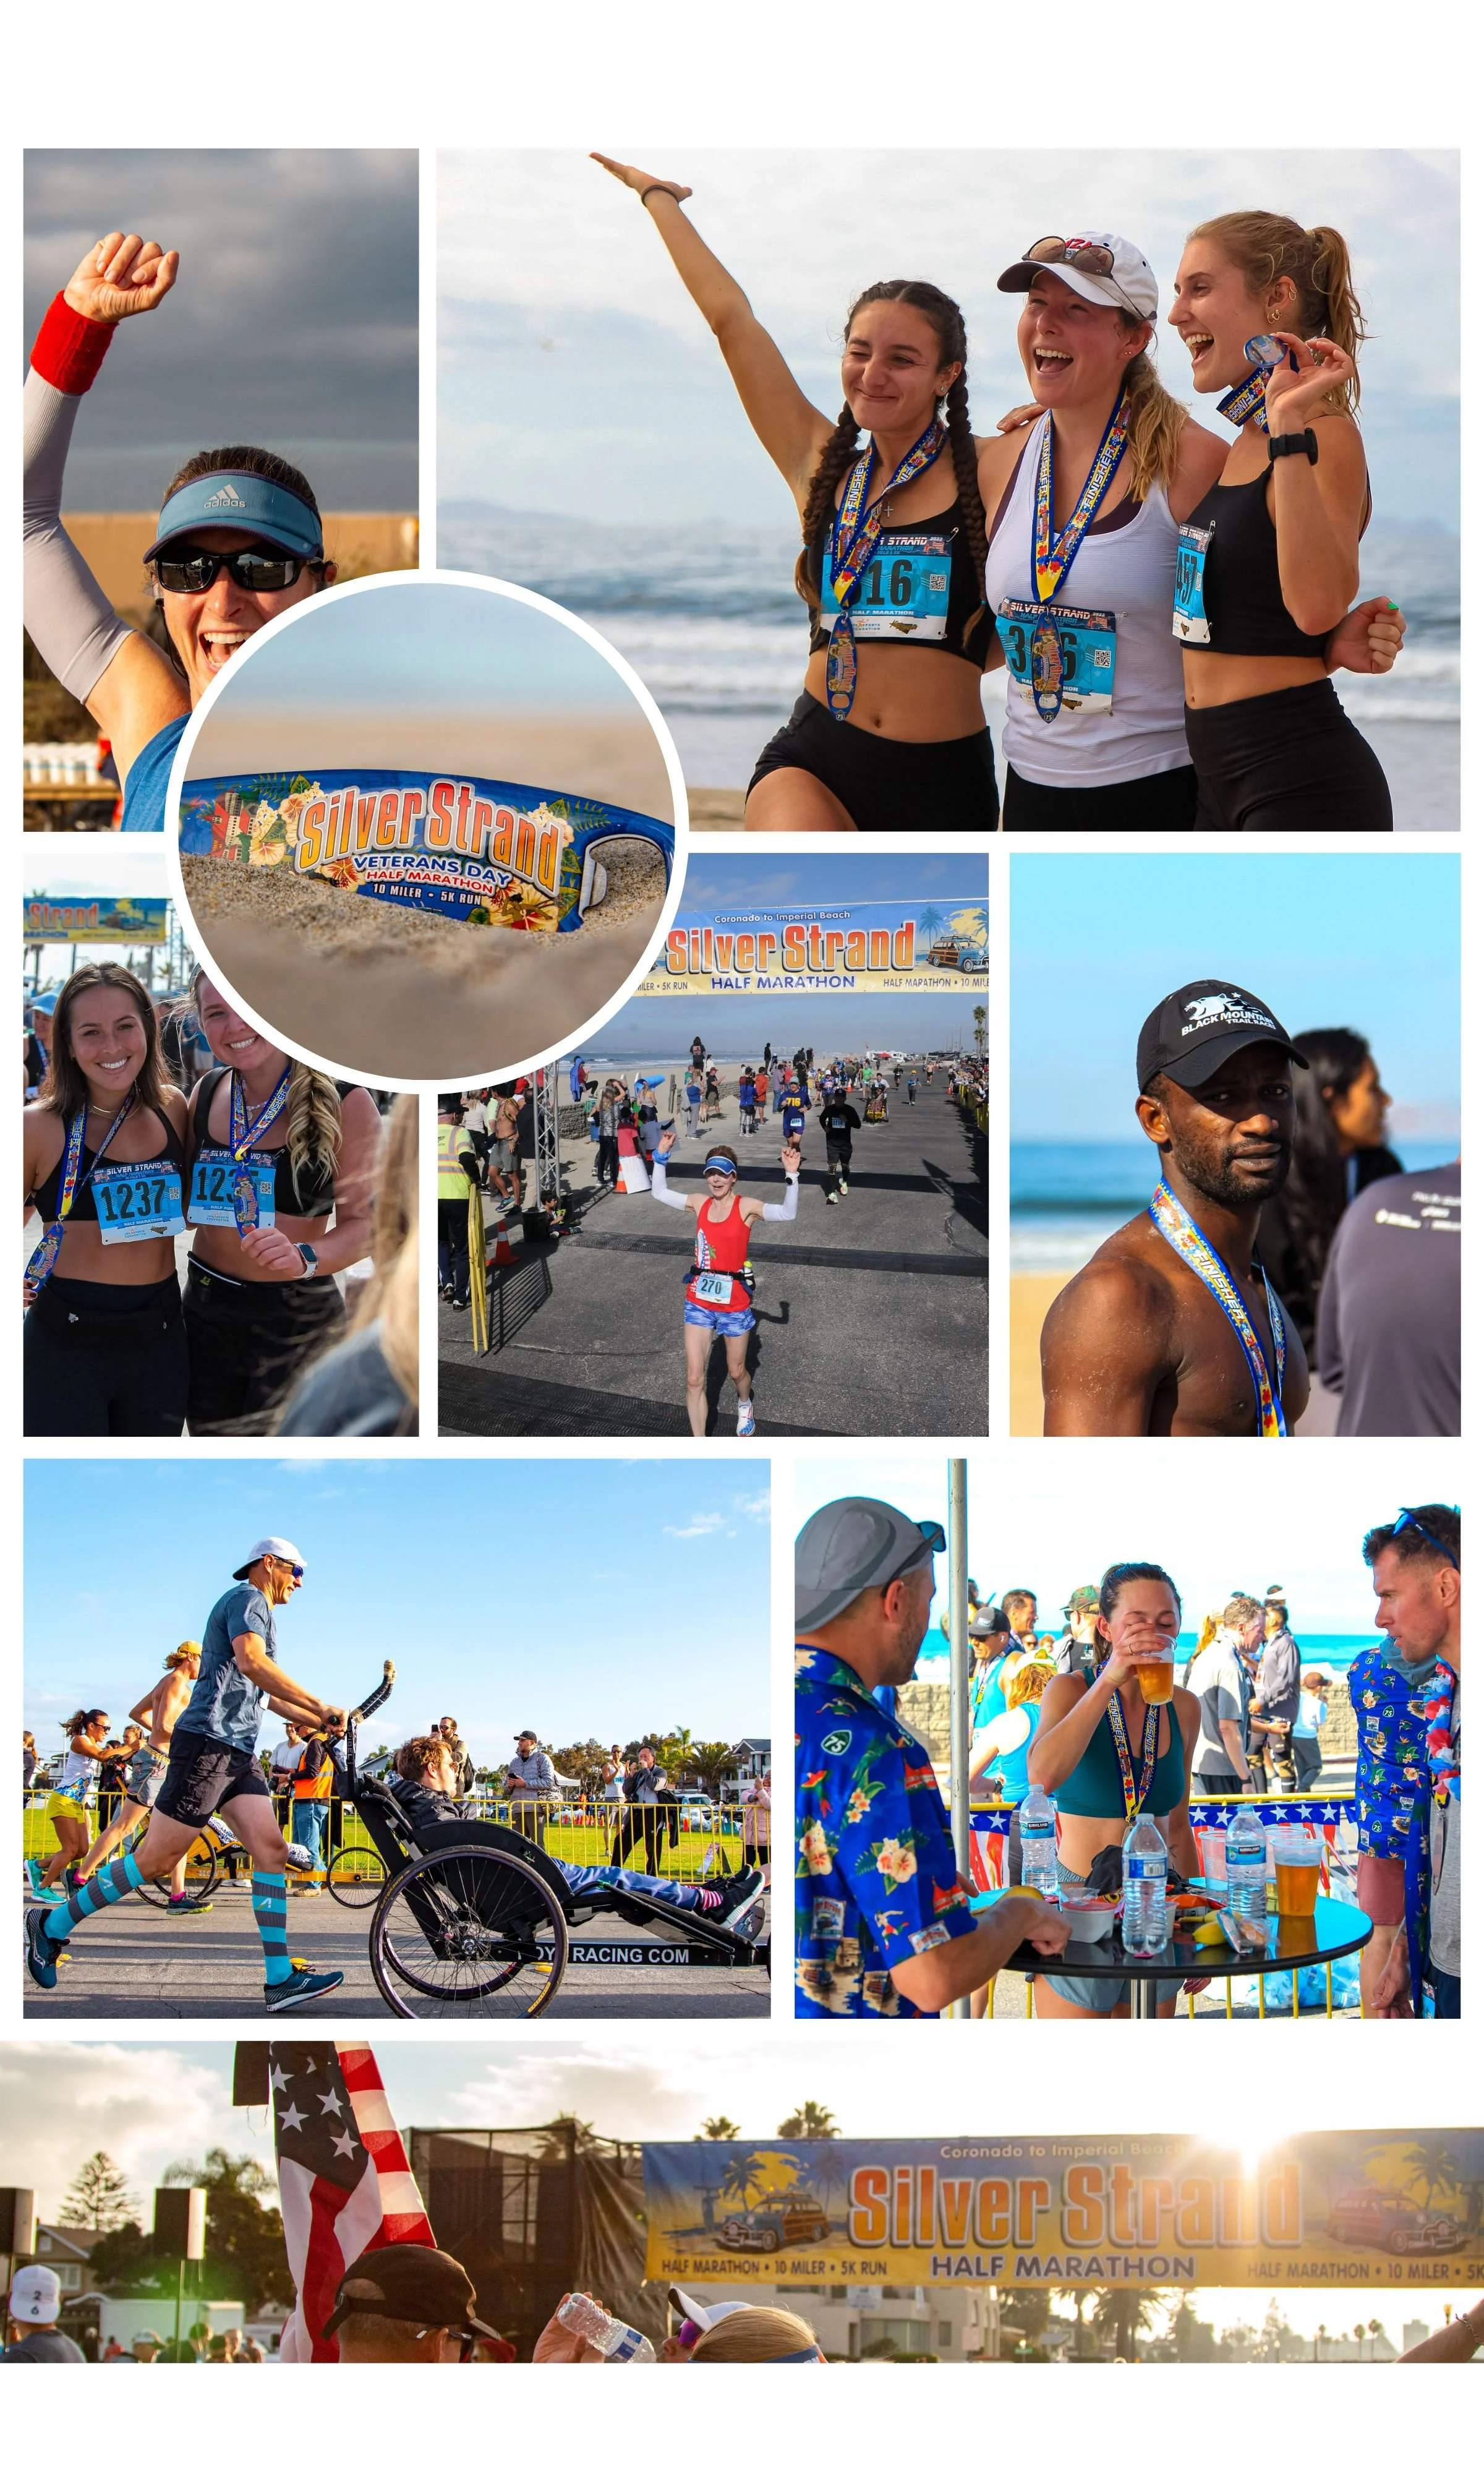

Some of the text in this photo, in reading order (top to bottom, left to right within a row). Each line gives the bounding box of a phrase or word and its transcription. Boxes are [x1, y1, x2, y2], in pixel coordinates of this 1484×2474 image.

[1041, 437, 1049, 495] FINISHER
[1083, 446, 1115, 508] FINISHER
[847, 461, 866, 508] FINISHER
[204, 499, 245, 508] adidas
[887, 537, 927, 546] STRAND
[1009, 625, 1077, 681] 36
[299, 781, 561, 894] Silver Strand
[354, 855, 510, 886] VETERANS DAY
[367, 870, 493, 894] HALF MARATHON
[373, 883, 482, 905] 10 MILER 5K RUN
[28, 902, 99, 928] Strand
[714, 910, 851, 923] Coronado to Imperial Beach
[666, 920, 916, 973] Silver Strand
[673, 982, 688, 990] RUN
[711, 975, 855, 990] HALF MARATHON
[884, 978, 903, 987] HALF
[905, 978, 951, 987] MARATHON
[961, 978, 970, 987] 10
[1182, 1011, 1274, 1036] BLACK MOUNTAIN
[1254, 1021, 1276, 1030] RACES
[267, 1090, 288, 1119] FINISHER
[787, 1097, 801, 1106] 716
[72, 1113, 83, 1145] NISHER
[106, 1166, 132, 1175] SILVER
[135, 1163, 161, 1171] STRAND
[197, 1166, 258, 1204] 123
[100, 1179, 166, 1222] 1237
[701, 1278, 722, 1295] 270
[1193, 1251, 1245, 1320] FINISHER
[1109, 1698, 1124, 1743] FINISHER
[1146, 1710, 1156, 1752] FINISHER
[825, 1736, 846, 1753] 75
[573, 1947, 642, 1963] RACING
[649, 1948, 689, 1963] COM
[940, 2141, 1185, 2160] Coronado to Imperial Beach
[851, 2164, 1301, 2248] Silver Strand
[662, 2259, 887, 2276] HALF MARATHON 10 MILER 5K RUN
[932, 2254, 1196, 2279] HALF MARATHON
[1247, 2262, 1484, 2280] HALF MARATHON 10 MILER 5K
[33, 2290, 41, 2301] 2
[31, 2306, 39, 2315] 6
